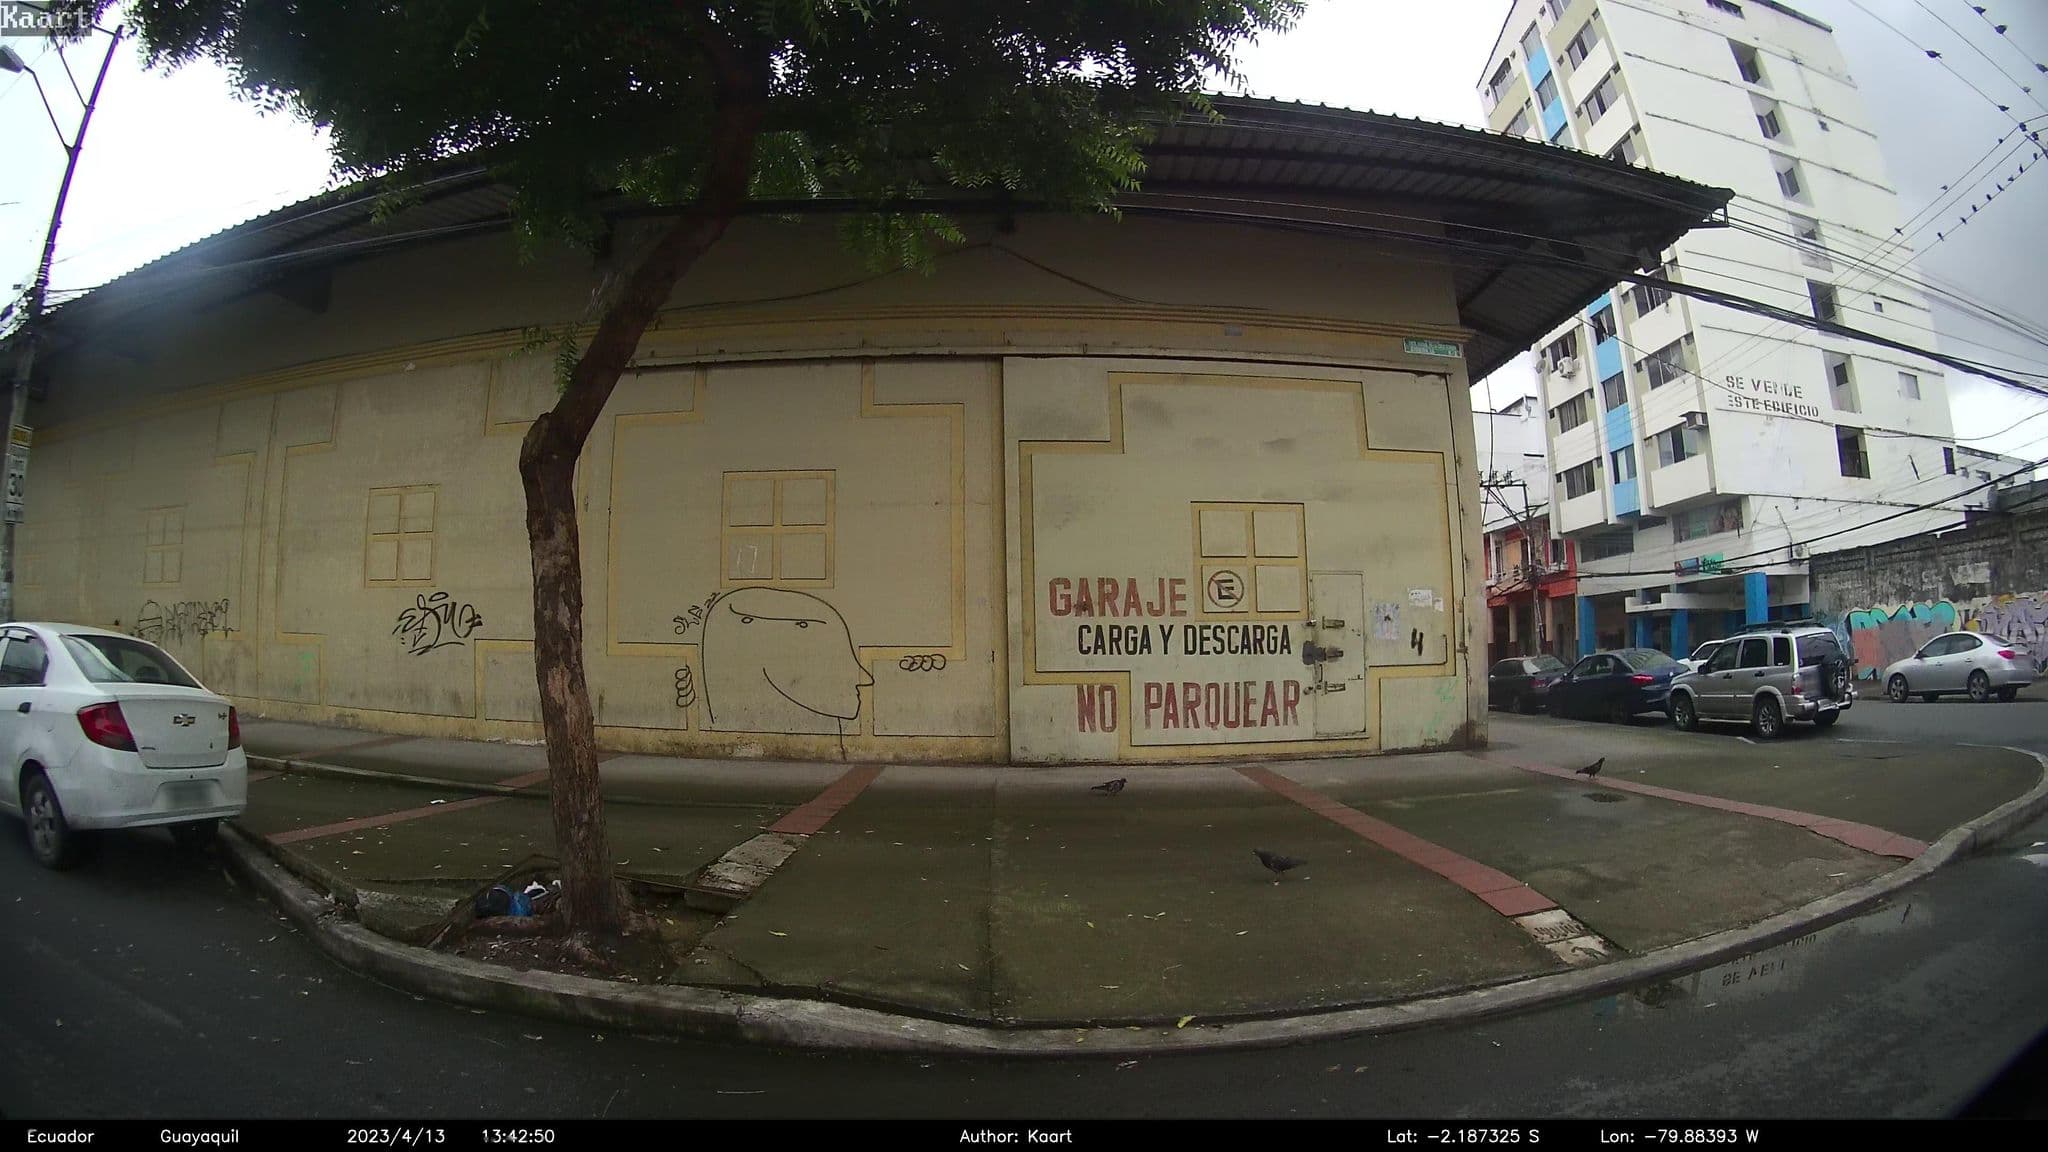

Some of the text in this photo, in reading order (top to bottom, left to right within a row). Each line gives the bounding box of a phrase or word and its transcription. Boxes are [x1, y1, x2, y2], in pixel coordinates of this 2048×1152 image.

[1725, 375, 1745, 390] SE
[1049, 577, 1187, 617] GARAJE
[1078, 624, 1292, 655] CARGA Y DESCARGA
[1411, 627, 1424, 656] 4
[1077, 680, 1300, 733] NO PARQUEAR
